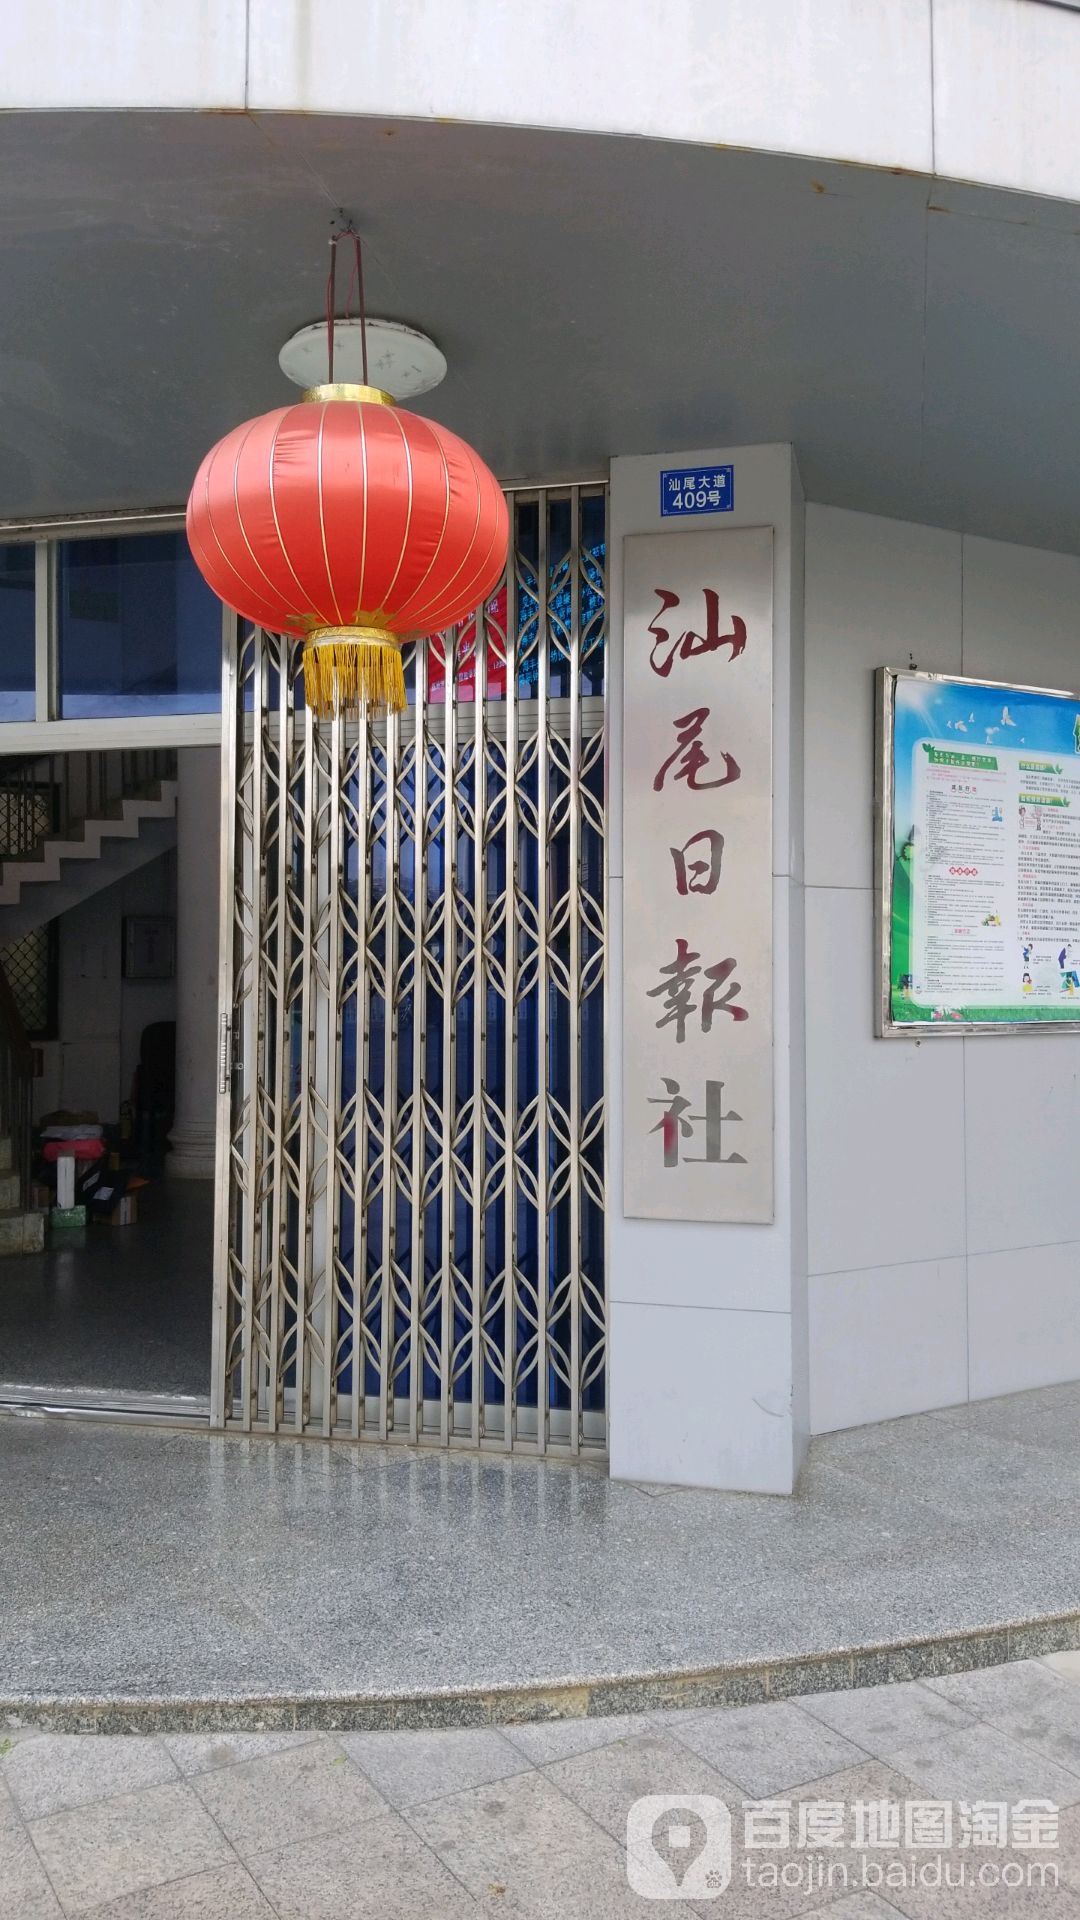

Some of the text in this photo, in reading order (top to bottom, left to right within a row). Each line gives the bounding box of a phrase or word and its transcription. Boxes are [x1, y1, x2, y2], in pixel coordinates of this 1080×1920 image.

[668, 474, 726, 492] 汕尾大道
[672, 490, 721, 510] 409号
[646, 588, 749, 1168] 汕尾日報社
